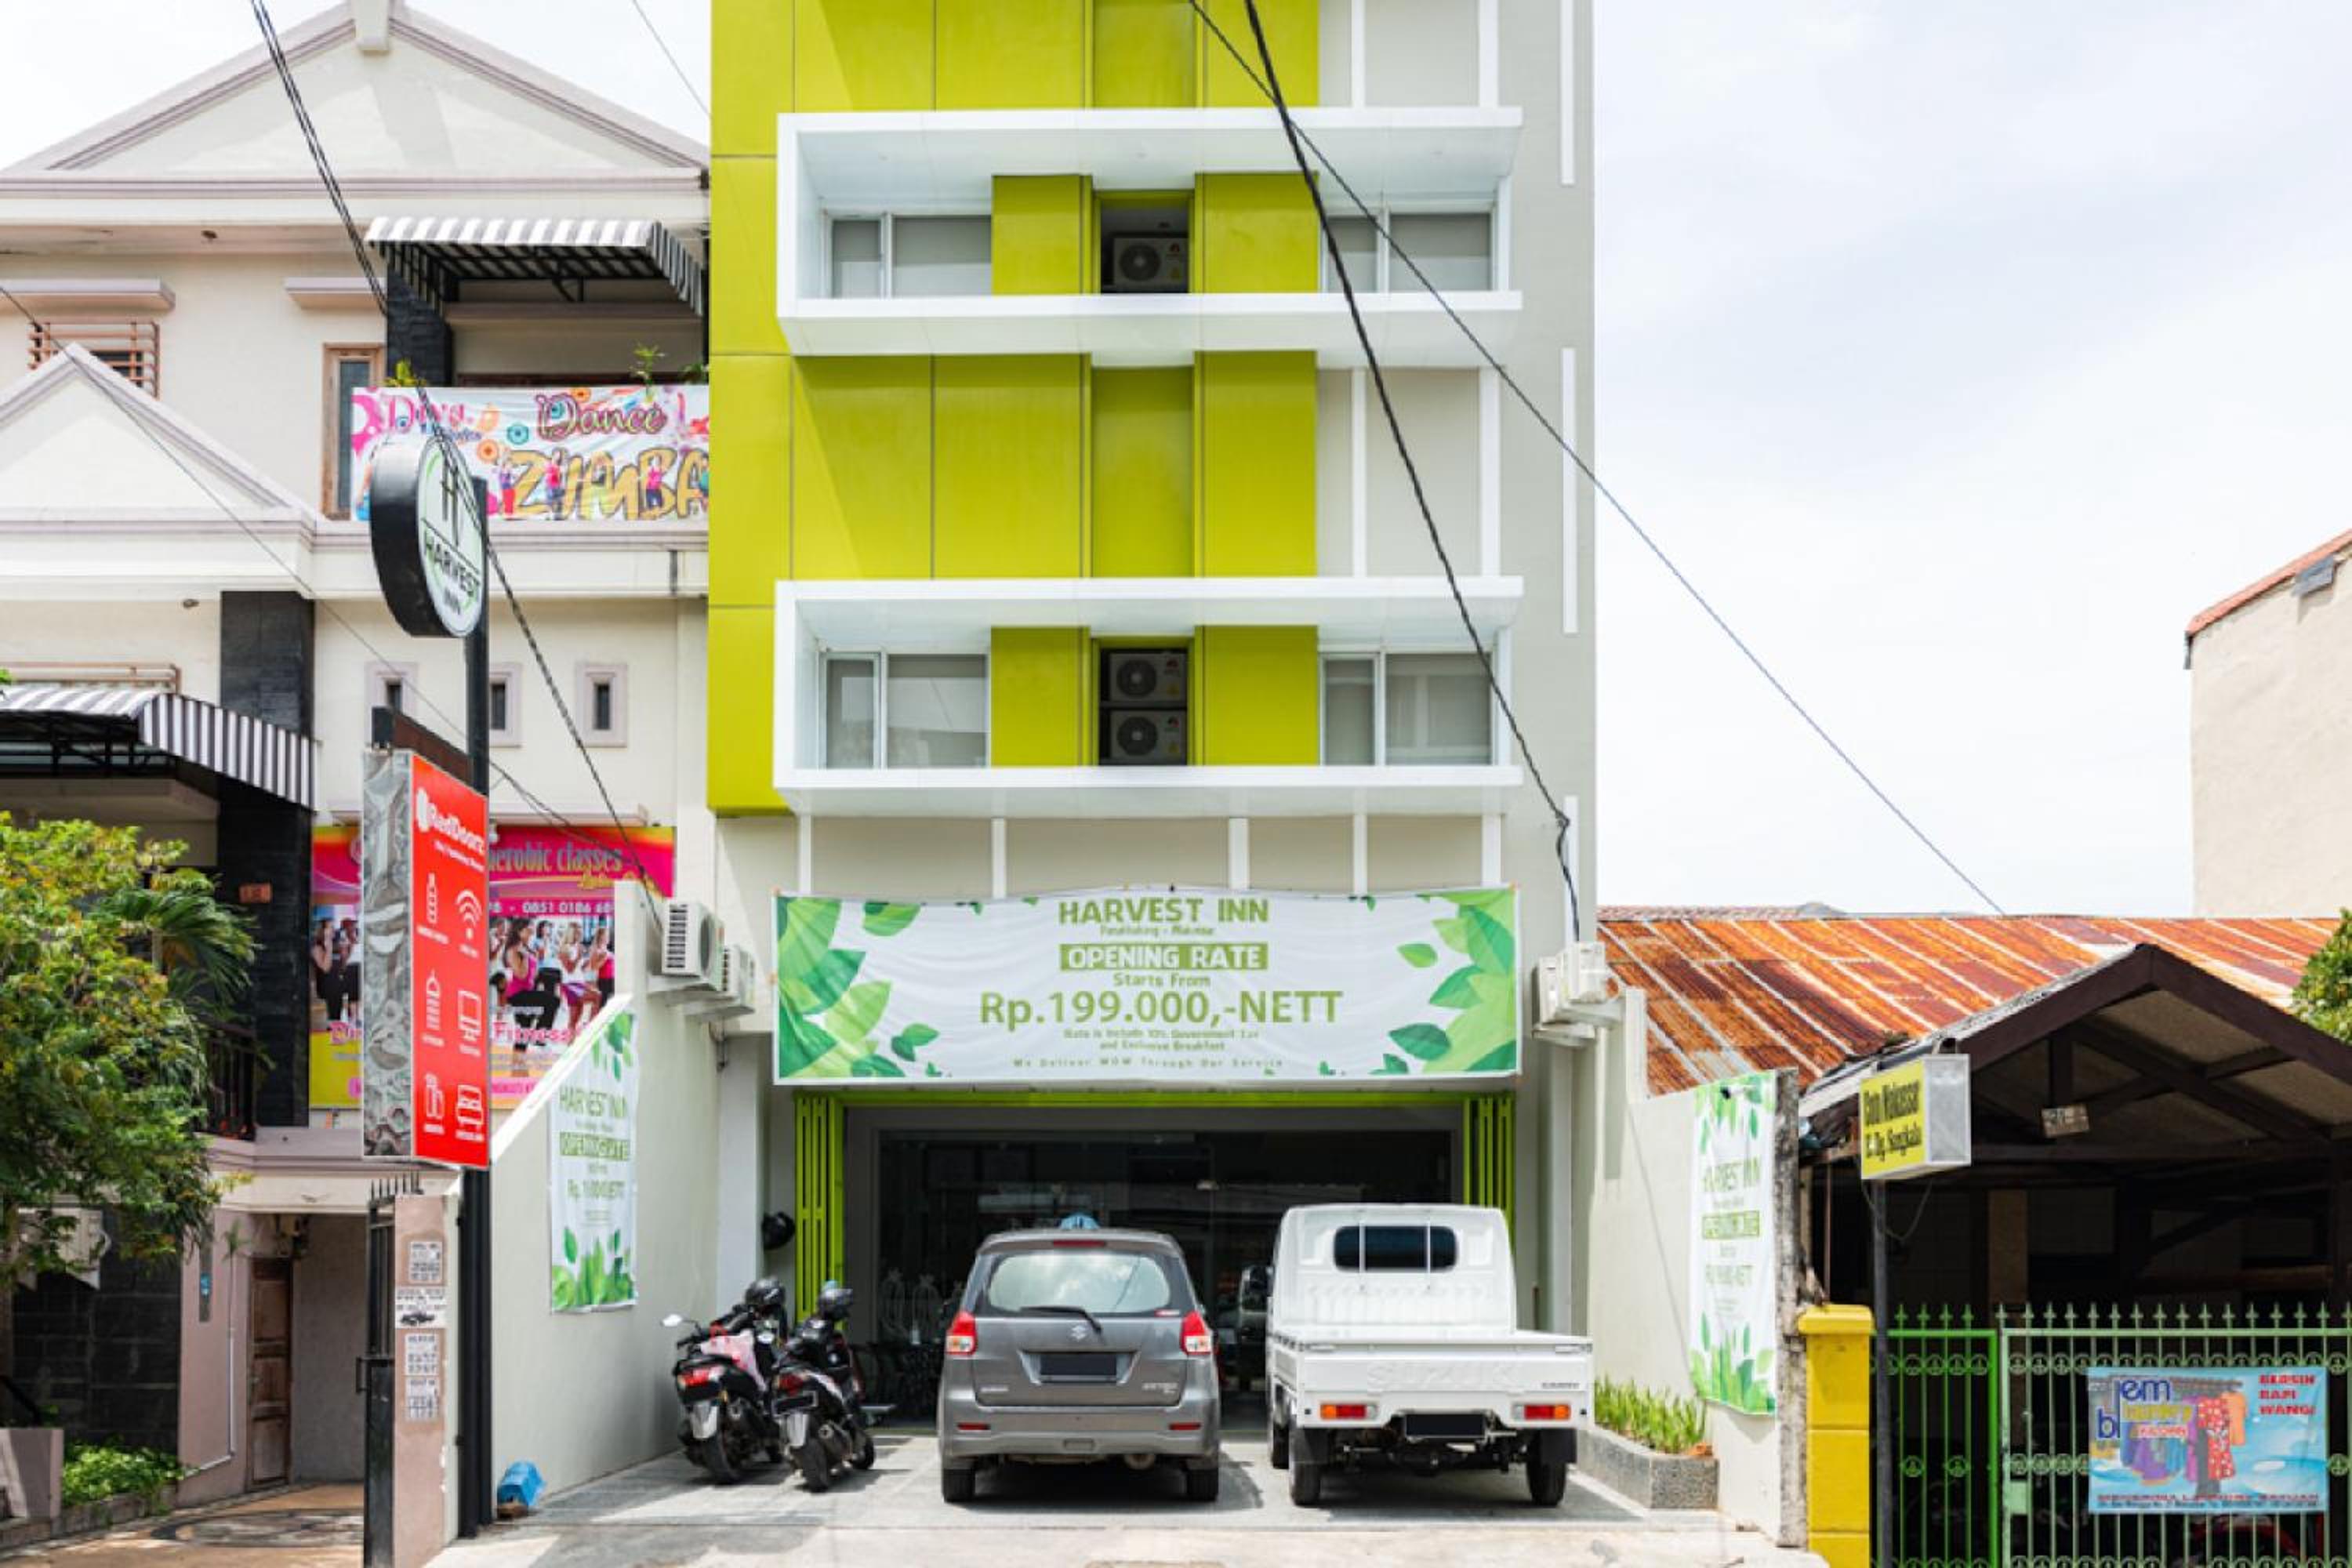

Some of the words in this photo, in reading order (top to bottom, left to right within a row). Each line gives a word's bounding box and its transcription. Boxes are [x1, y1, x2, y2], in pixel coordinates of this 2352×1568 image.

[535, 393, 668, 442] Dance
[424, 529, 481, 598] HARVEST
[557, 840, 622, 872] classes
[1058, 898, 1203, 924] HARVEST
[1218, 898, 1269, 922] INN
[1069, 946, 1179, 969] OPENING
[1191, 946, 1261, 968] RATE
[1112, 972, 1165, 987] Starts
[1170, 973, 1211, 987] From
[980, 990, 1344, 1032] Rp.199.000,-NETT
[1369, 1363, 1526, 1394] SUZUK
